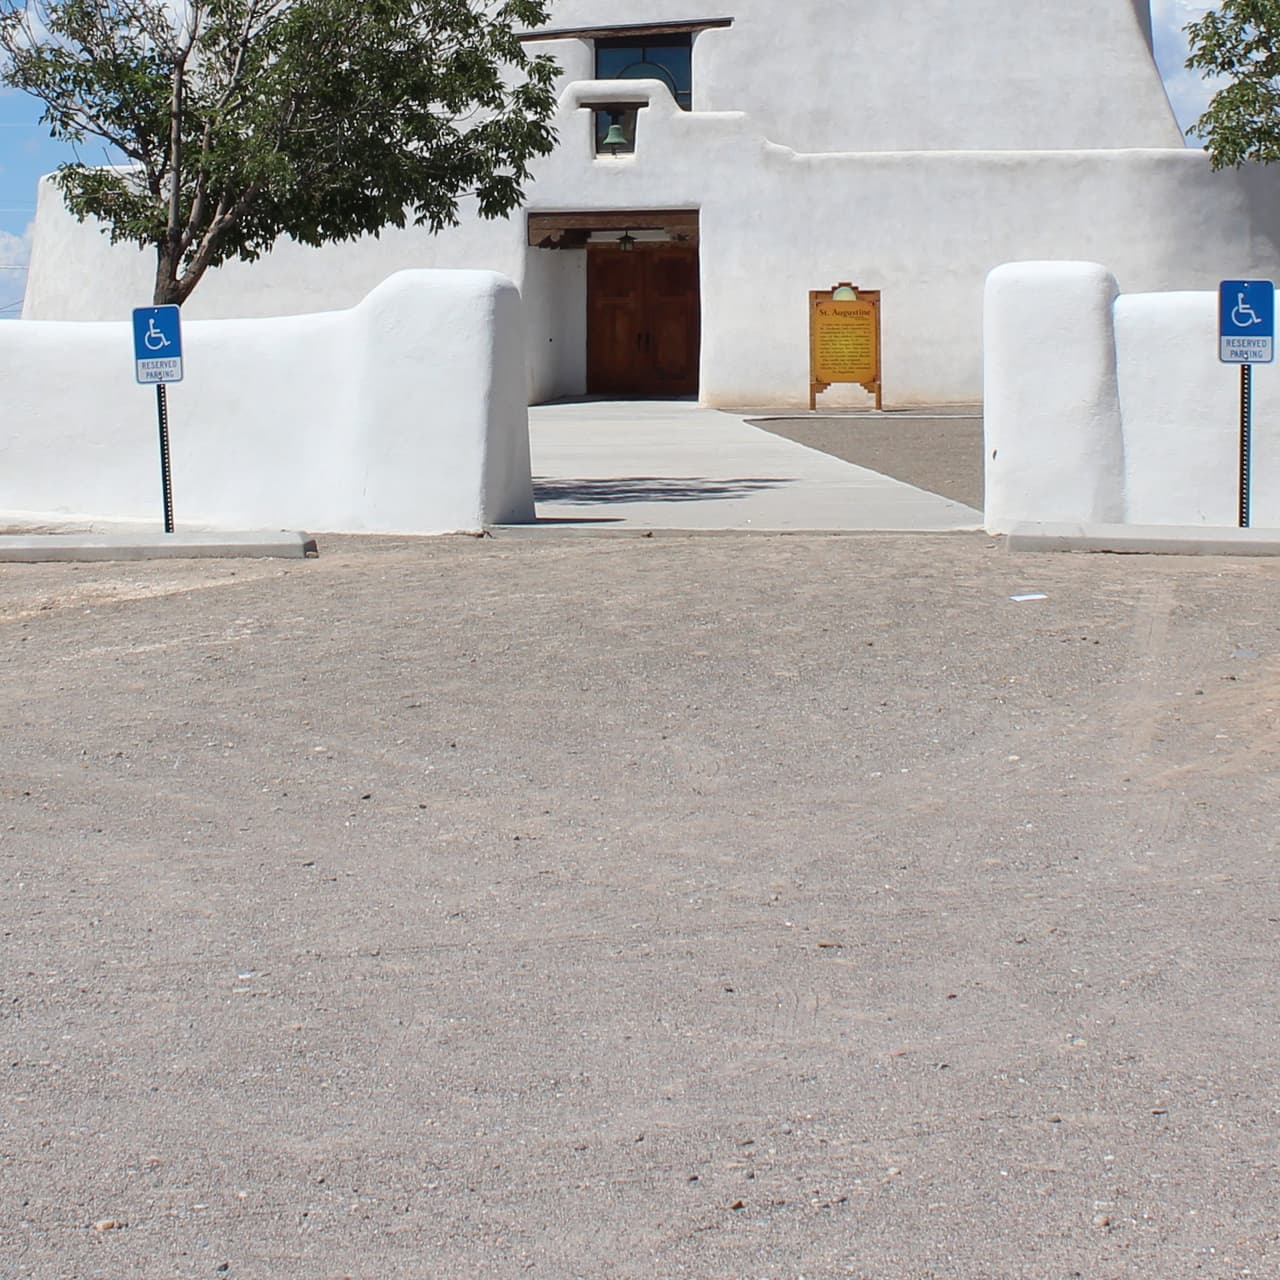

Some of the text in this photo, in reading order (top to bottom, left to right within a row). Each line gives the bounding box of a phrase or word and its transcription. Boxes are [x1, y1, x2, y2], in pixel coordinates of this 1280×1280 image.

[832, 307, 871, 318] Augustine
[1225, 339, 1267, 348] RESERVED
[141, 360, 177, 370] RESERVED
[145, 370, 174, 379] PARKING
